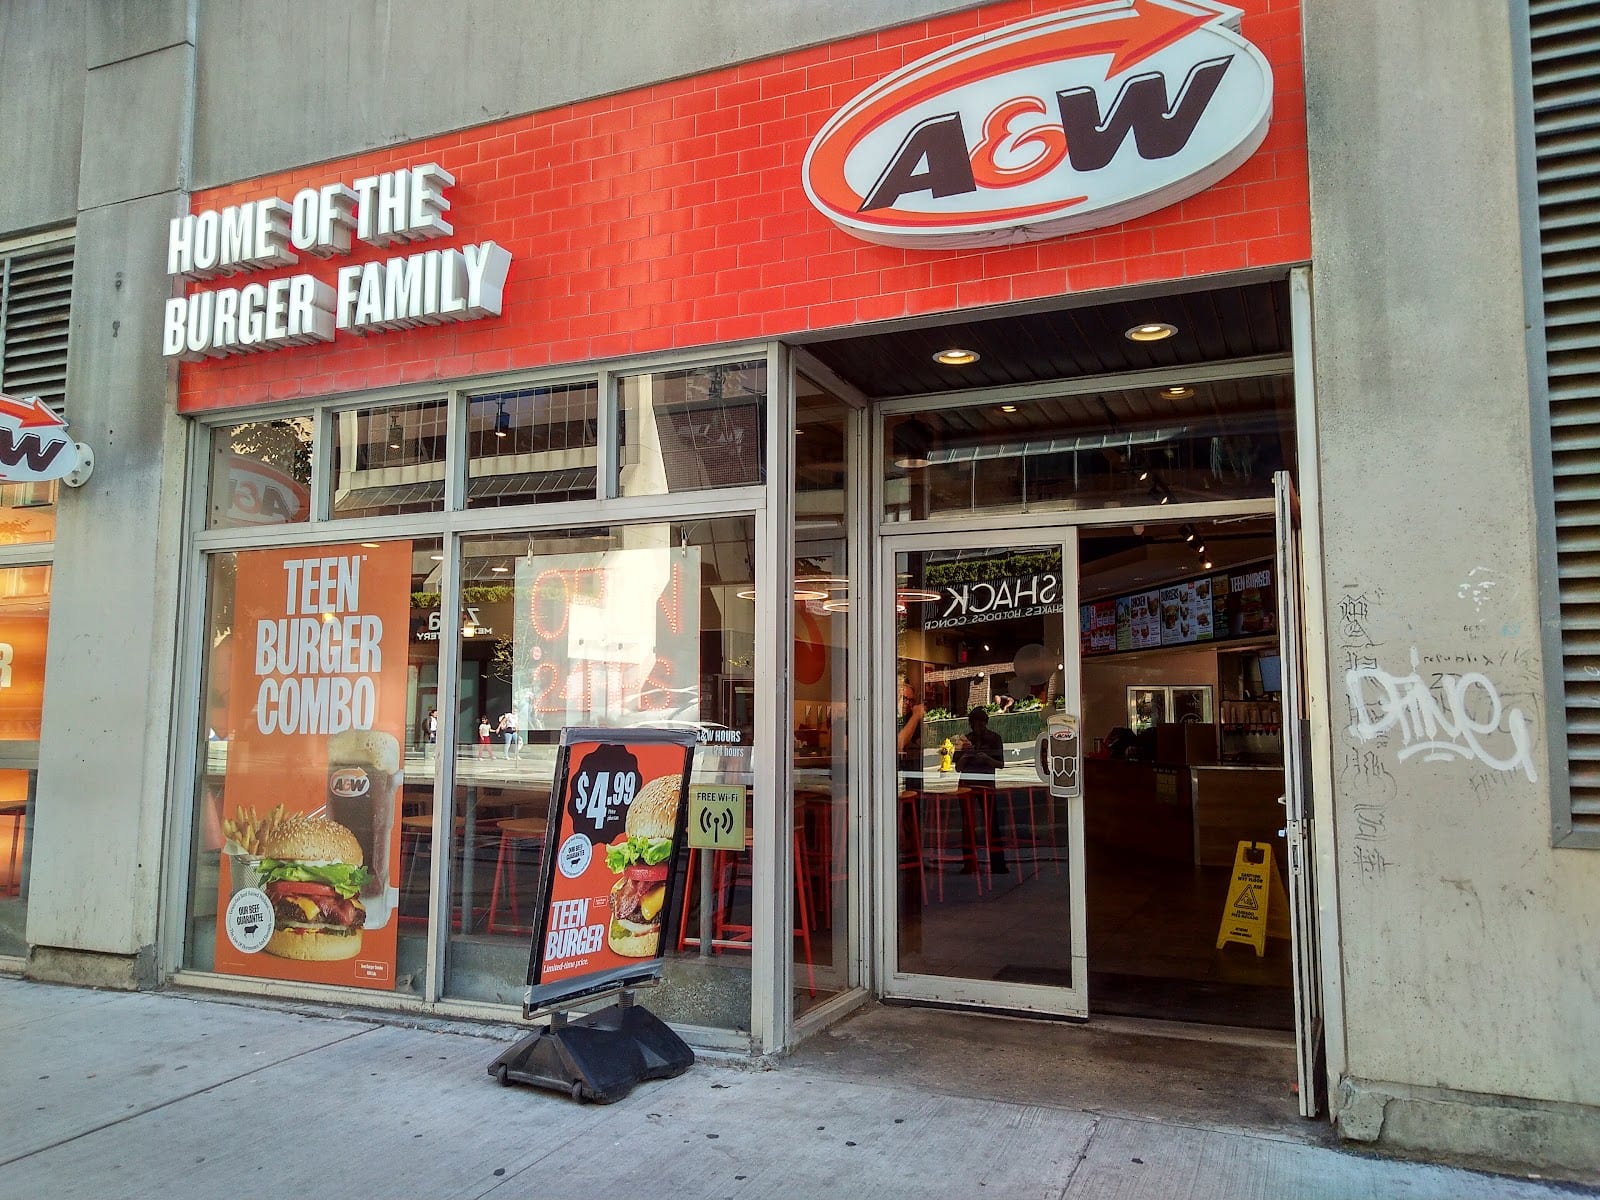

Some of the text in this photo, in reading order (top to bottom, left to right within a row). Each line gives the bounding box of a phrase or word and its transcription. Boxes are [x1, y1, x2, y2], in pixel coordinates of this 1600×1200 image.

[857, 54, 1235, 213] A&W
[168, 163, 450, 276] HOME OF THE
[163, 241, 506, 357] BURGER FAMILY
[283, 555, 361, 615] TEEN
[255, 614, 383, 676] BURGER
[257, 676, 376, 736] COMBO
[715, 730, 741, 742] HOURS
[724, 746, 744, 757] hours
[333, 777, 368, 792] A&W
[575, 771, 636, 830] $4.99
[697, 793, 738, 802] FREE Wi-Fi
[237, 913, 264, 925] GUARANTEE
[239, 904, 260, 915] OUR BEEF
[551, 899, 589, 930] TEEN
[545, 923, 605, 961] BURGER
